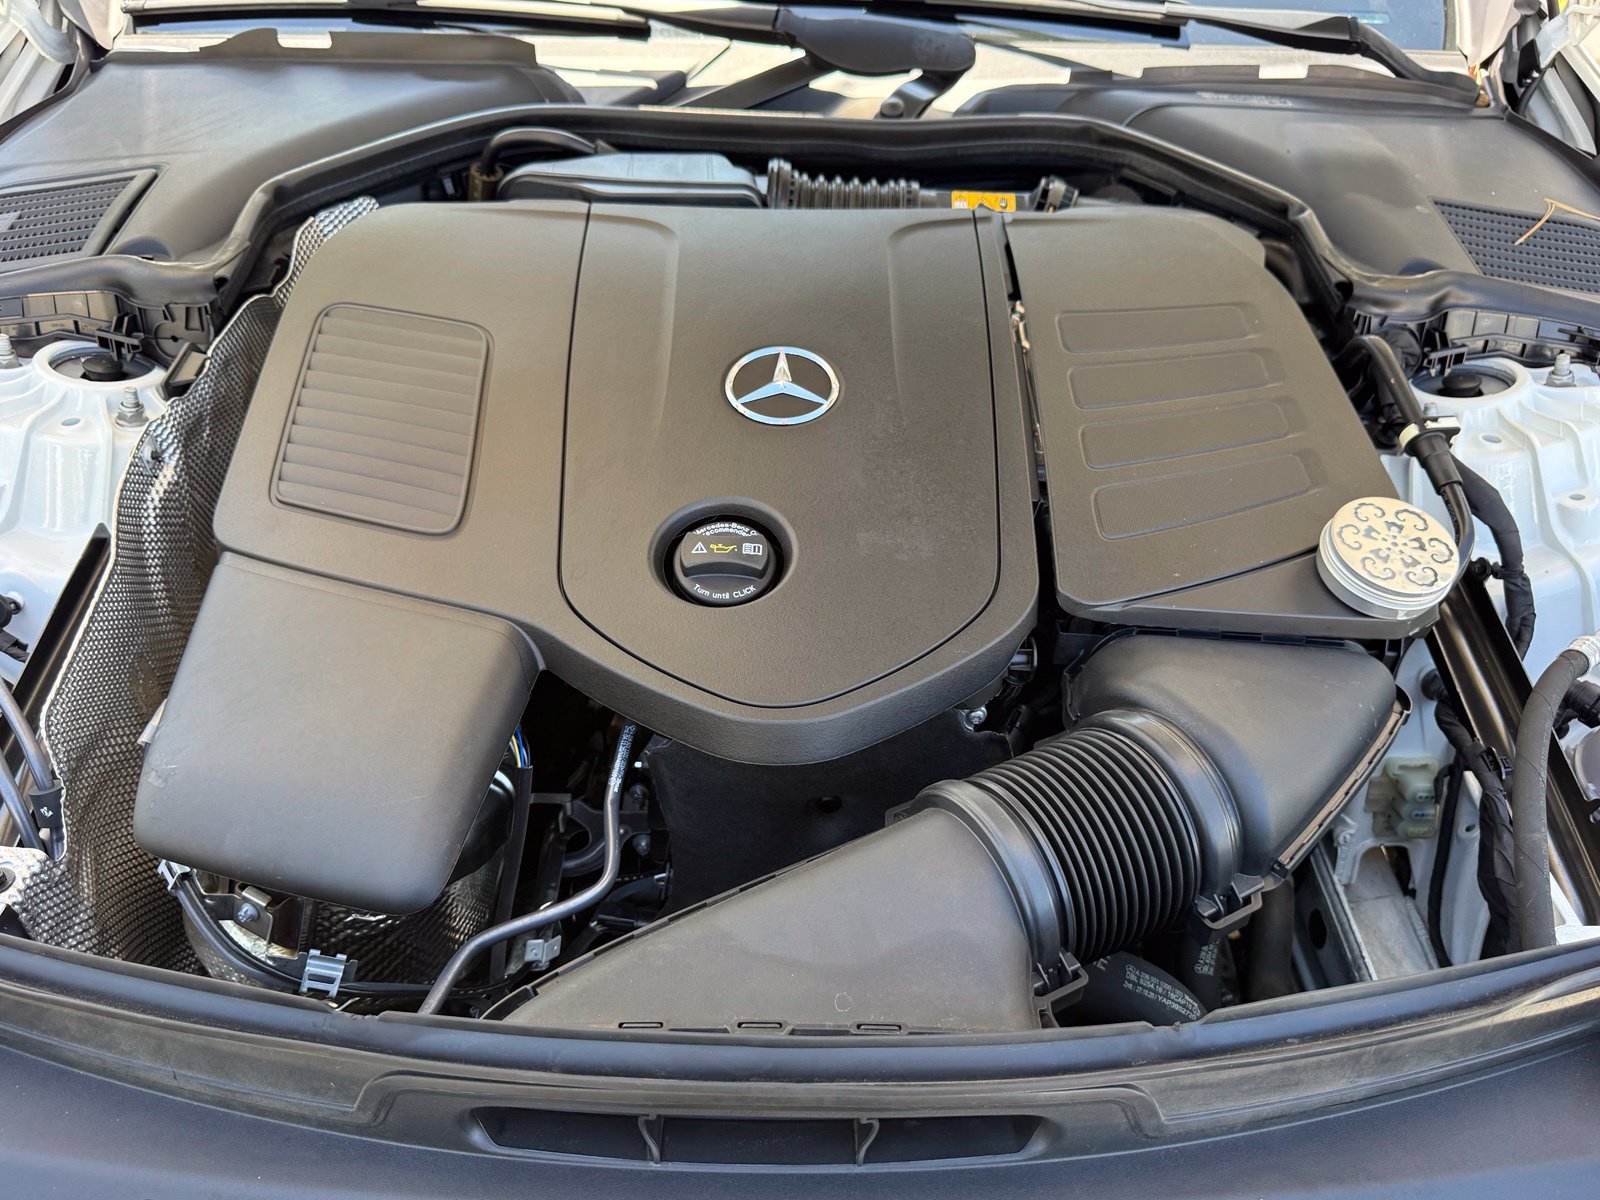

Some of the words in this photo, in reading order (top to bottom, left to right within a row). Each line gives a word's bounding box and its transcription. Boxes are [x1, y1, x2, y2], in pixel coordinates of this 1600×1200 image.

[693, 583, 710, 598] Turn
[712, 591, 730, 600] until
[732, 584, 757, 599] CLICK
[1125, 971, 1138, 983] DBL
